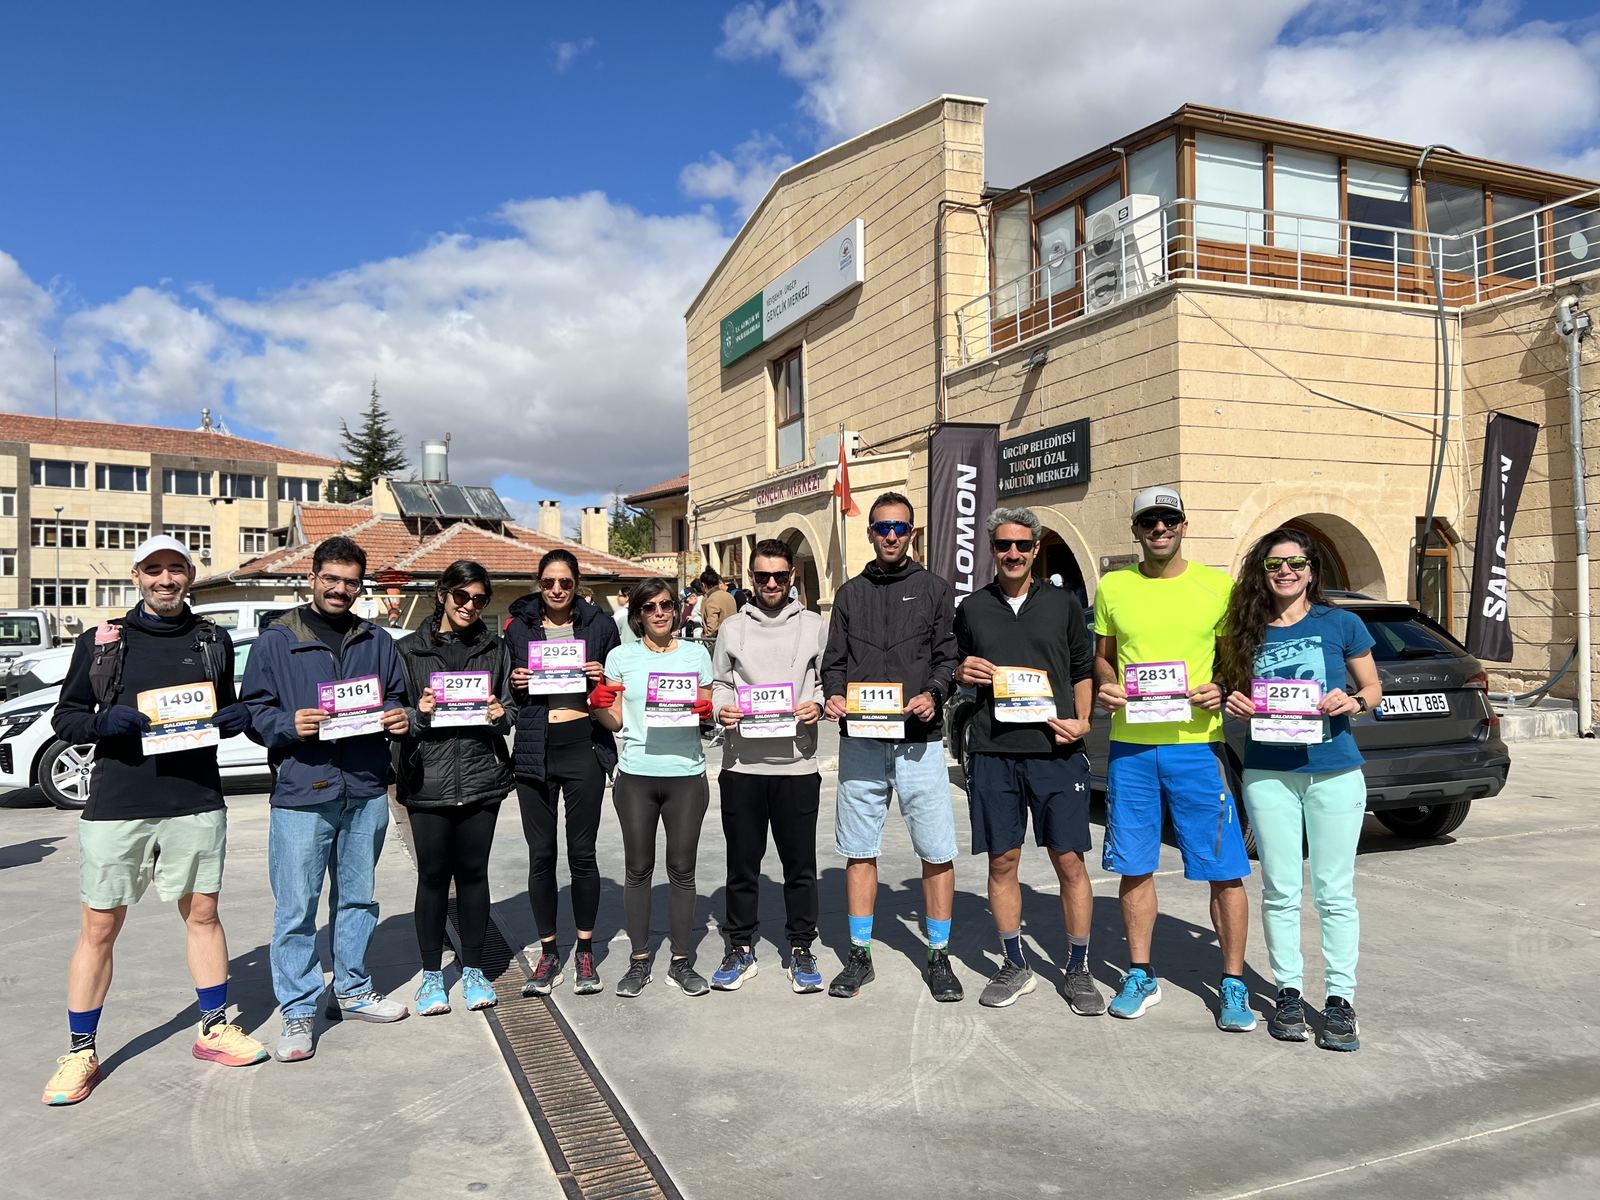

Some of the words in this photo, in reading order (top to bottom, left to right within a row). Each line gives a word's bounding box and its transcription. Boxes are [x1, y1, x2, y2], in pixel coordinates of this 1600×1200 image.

[787, 281, 810, 310] MERKEZİ
[1030, 429, 1076, 453] BELEDİYESİ
[1044, 450, 1067, 466] ÖZAL
[1004, 474, 1034, 491] KÜLTÜR
[1036, 463, 1074, 484] MERKEZİ
[543, 646, 577, 657] 2925
[1008, 672, 1041, 684] 1477
[1138, 668, 1176, 681] 2831
[445, 678, 482, 689] 2977
[659, 679, 692, 690] 2733
[337, 683, 371, 699] 3161
[752, 689, 785, 701] 3071
[860, 689, 893, 700] 1111
[1269, 686, 1310, 699] 2871
[159, 690, 204, 707] 1490
[1382, 696, 1396, 713] 34
[1400, 695, 1422, 712] KIZ
[1426, 694, 1446, 711] 885
[163, 720, 198, 729] SALOMON
